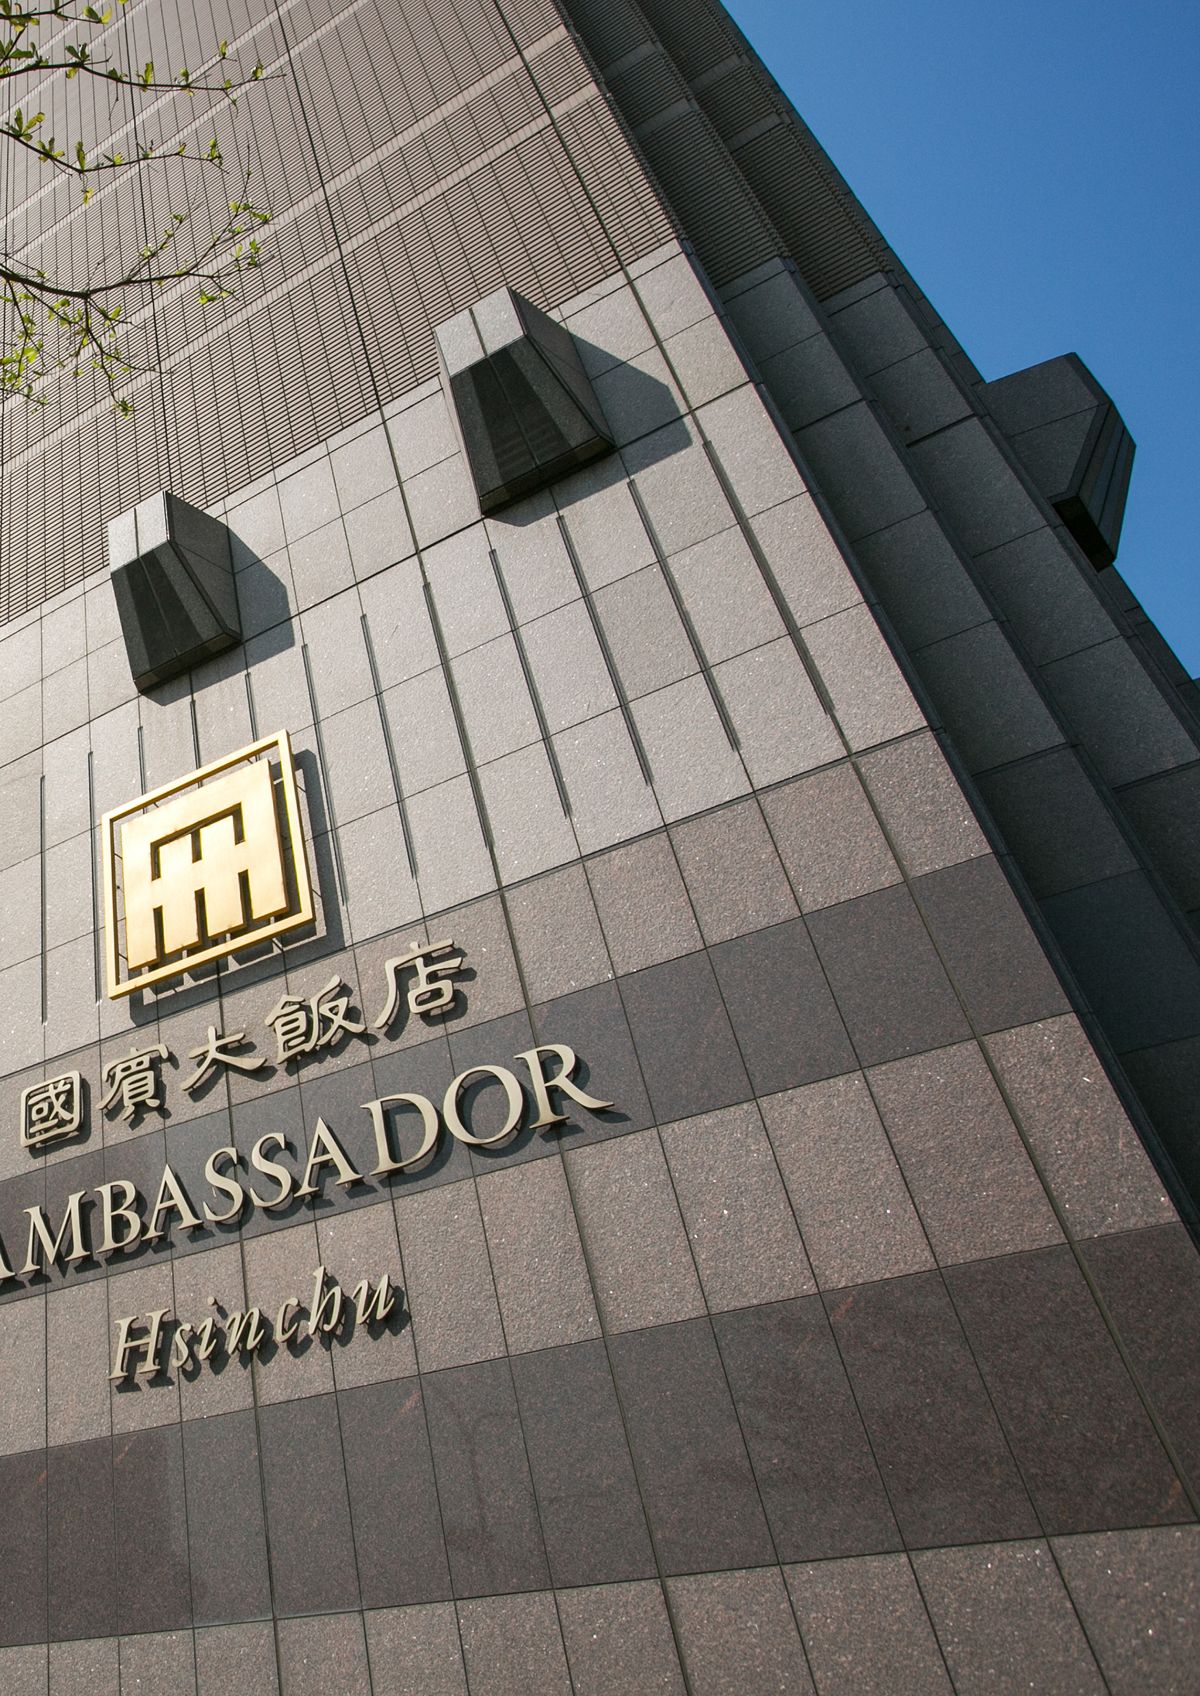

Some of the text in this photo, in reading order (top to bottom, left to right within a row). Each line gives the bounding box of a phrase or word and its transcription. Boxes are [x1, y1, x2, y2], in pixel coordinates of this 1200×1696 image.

[20, 938, 464, 1148] 國賓大飯店
[108, 1265, 395, 1380] Hsinchu
